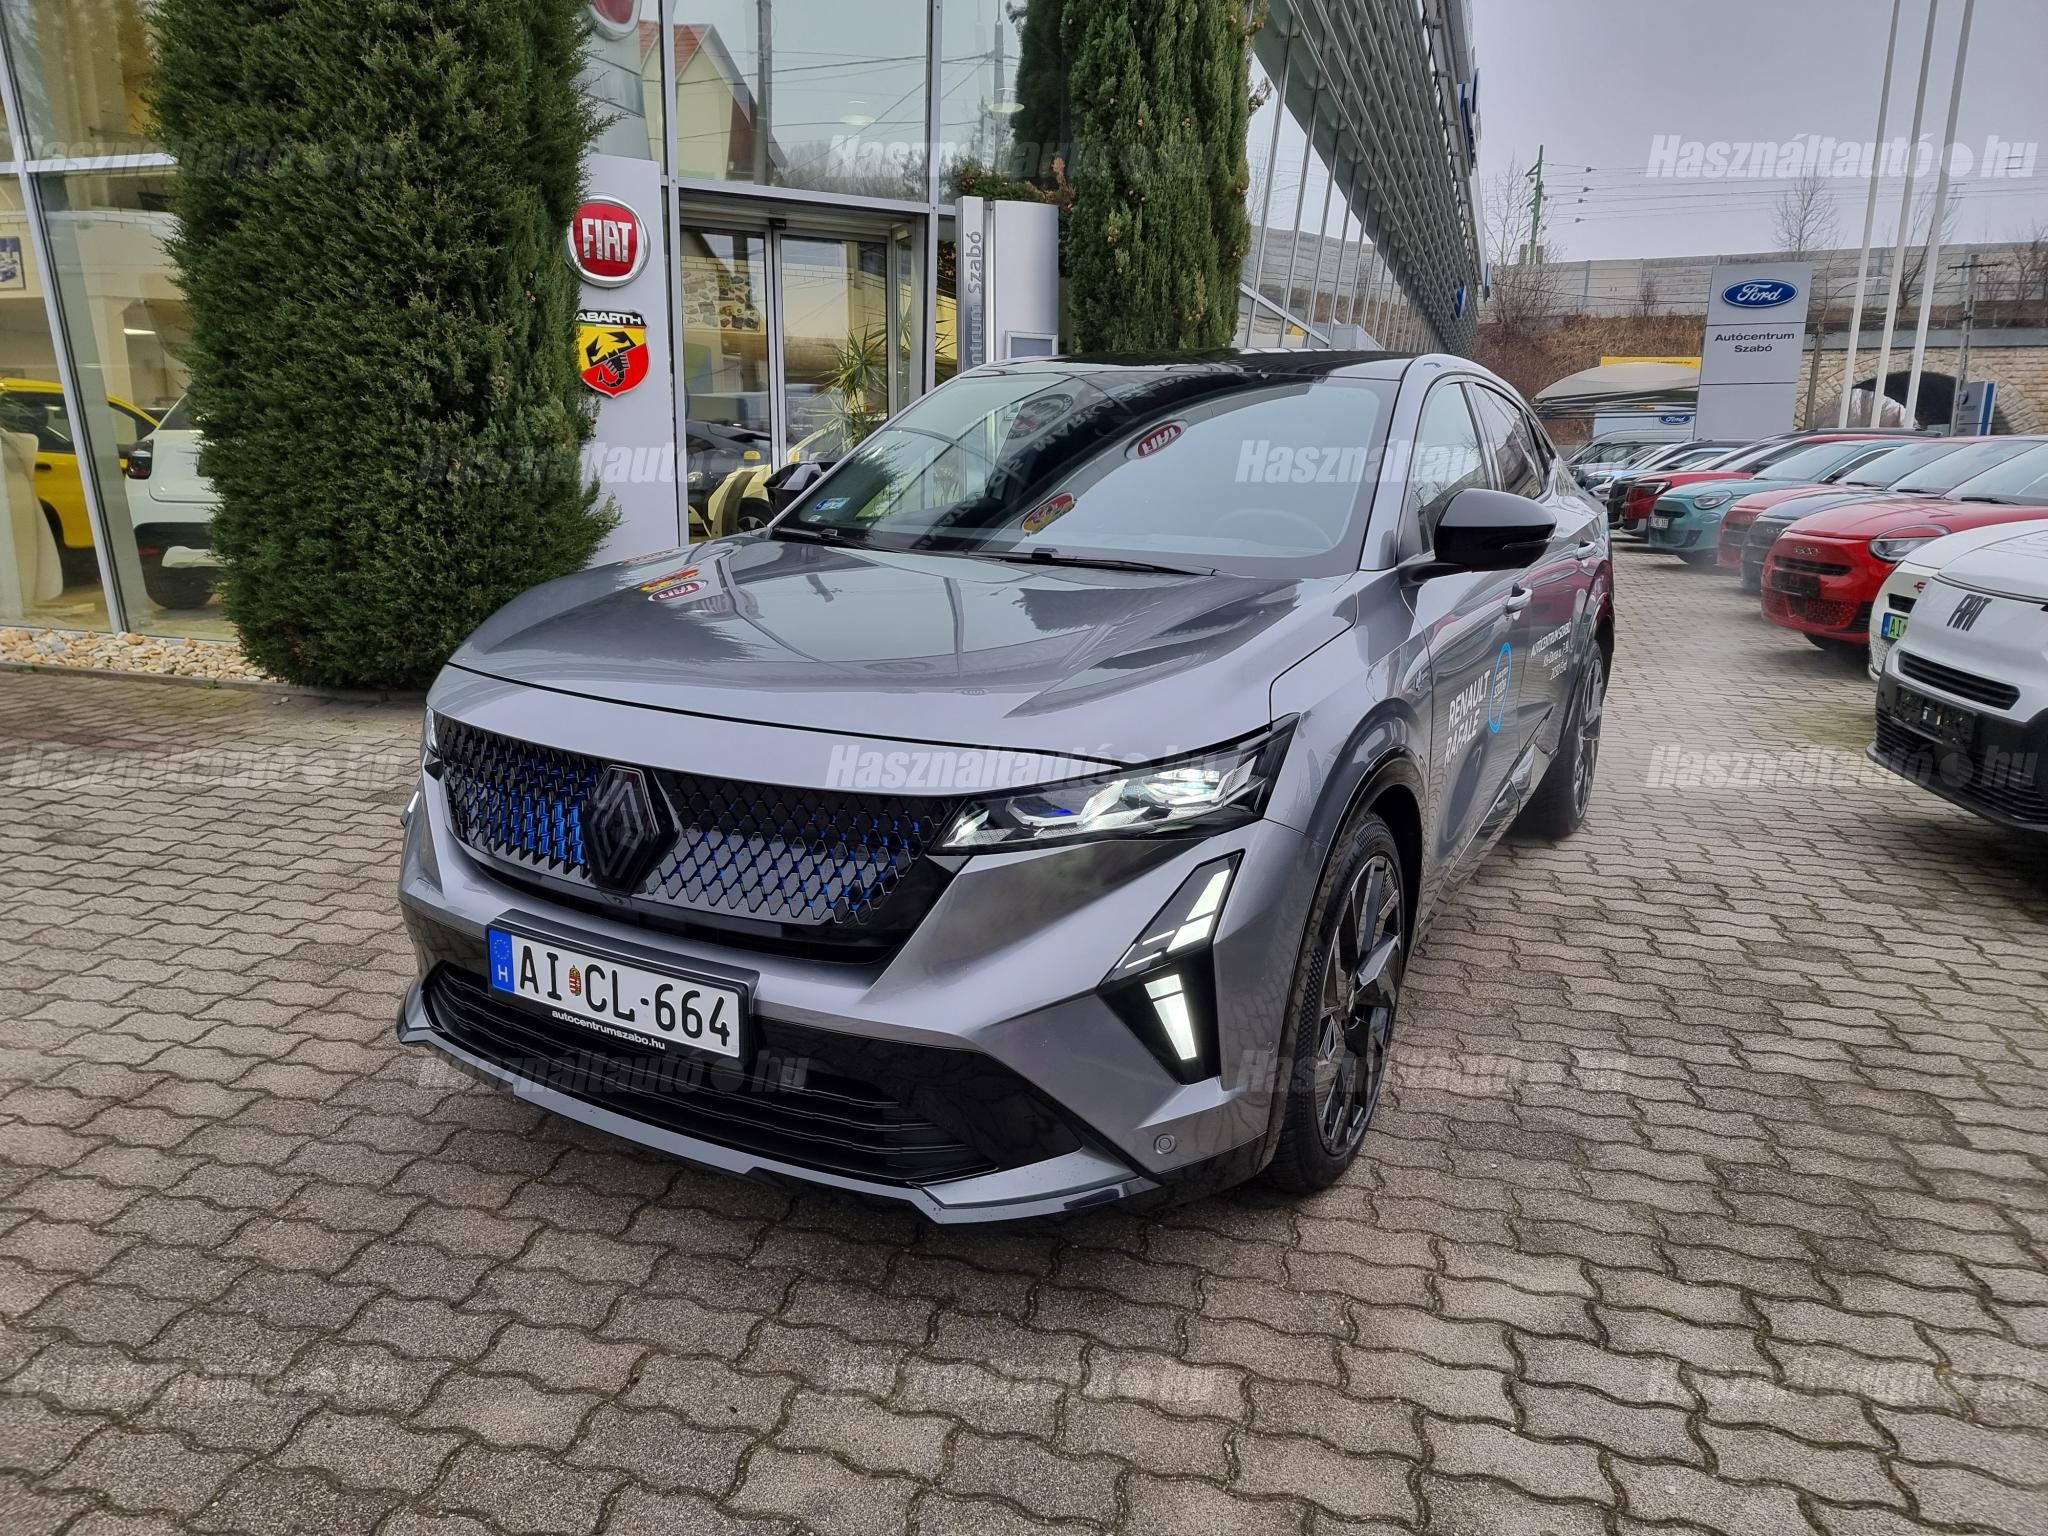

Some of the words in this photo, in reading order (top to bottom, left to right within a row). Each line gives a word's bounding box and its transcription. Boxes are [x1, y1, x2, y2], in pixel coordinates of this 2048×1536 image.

[581, 217, 633, 263] FIAT
[965, 231, 982, 294] Szabó
[1736, 283, 1784, 301] Ford
[576, 311, 642, 325] ABARTH
[1714, 332, 1795, 342] Autócentrum
[1734, 343, 1773, 353] Szabó
[1946, 593, 1993, 632] FIAT
[1448, 670, 1491, 733] RENAULT
[1444, 708, 1481, 768] RAFALE
[498, 964, 508, 983] H
[551, 1010, 666, 1051] autocentrumszabo.hu
